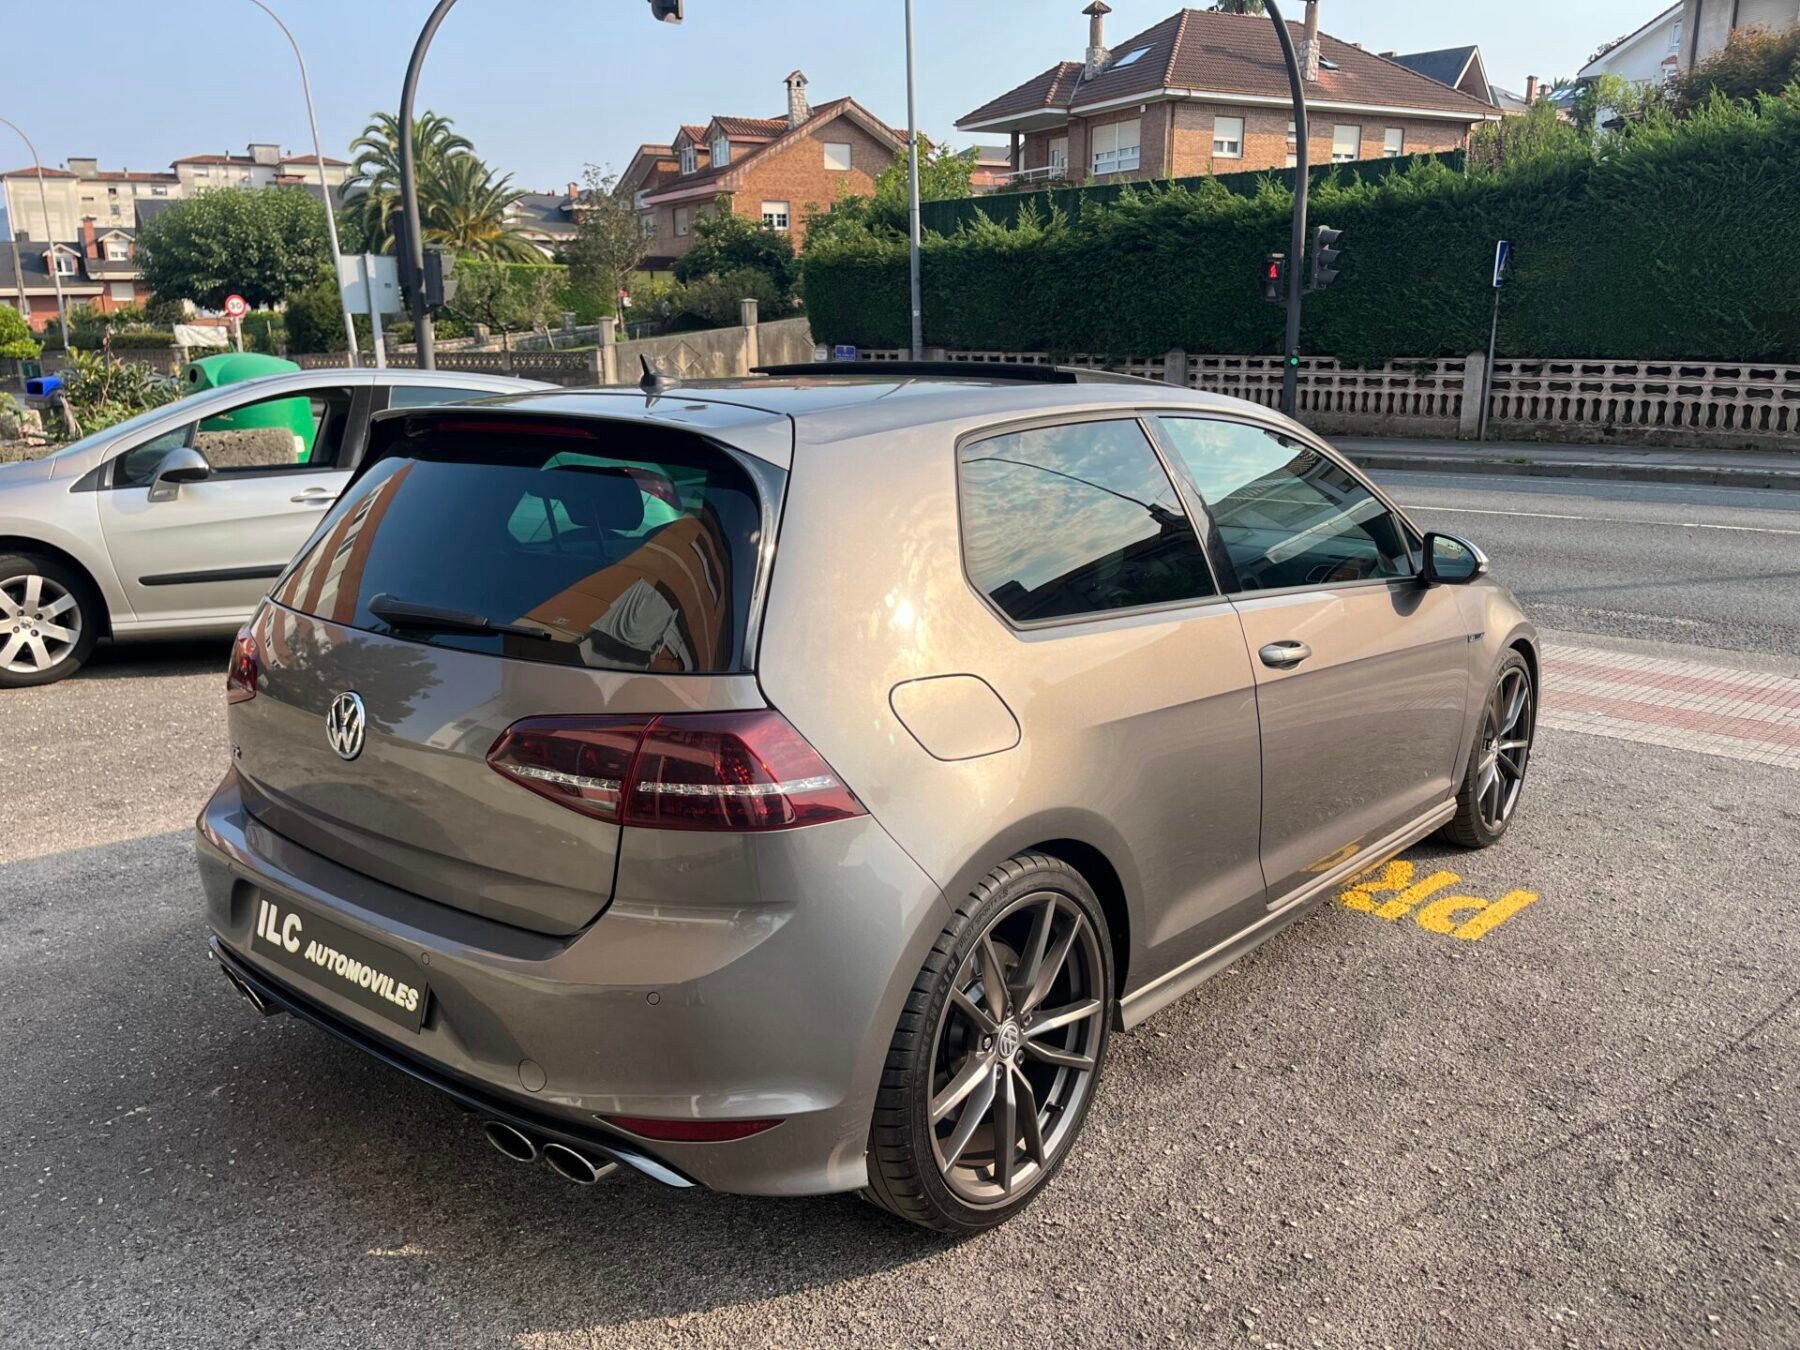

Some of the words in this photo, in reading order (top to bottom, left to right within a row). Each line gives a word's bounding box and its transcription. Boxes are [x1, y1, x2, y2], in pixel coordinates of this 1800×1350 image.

[229, 301, 242, 310] 30
[256, 899, 303, 953] ILC
[304, 939, 420, 1012] AUTOMOVILES
[919, 957, 957, 1062] MICHELIN
